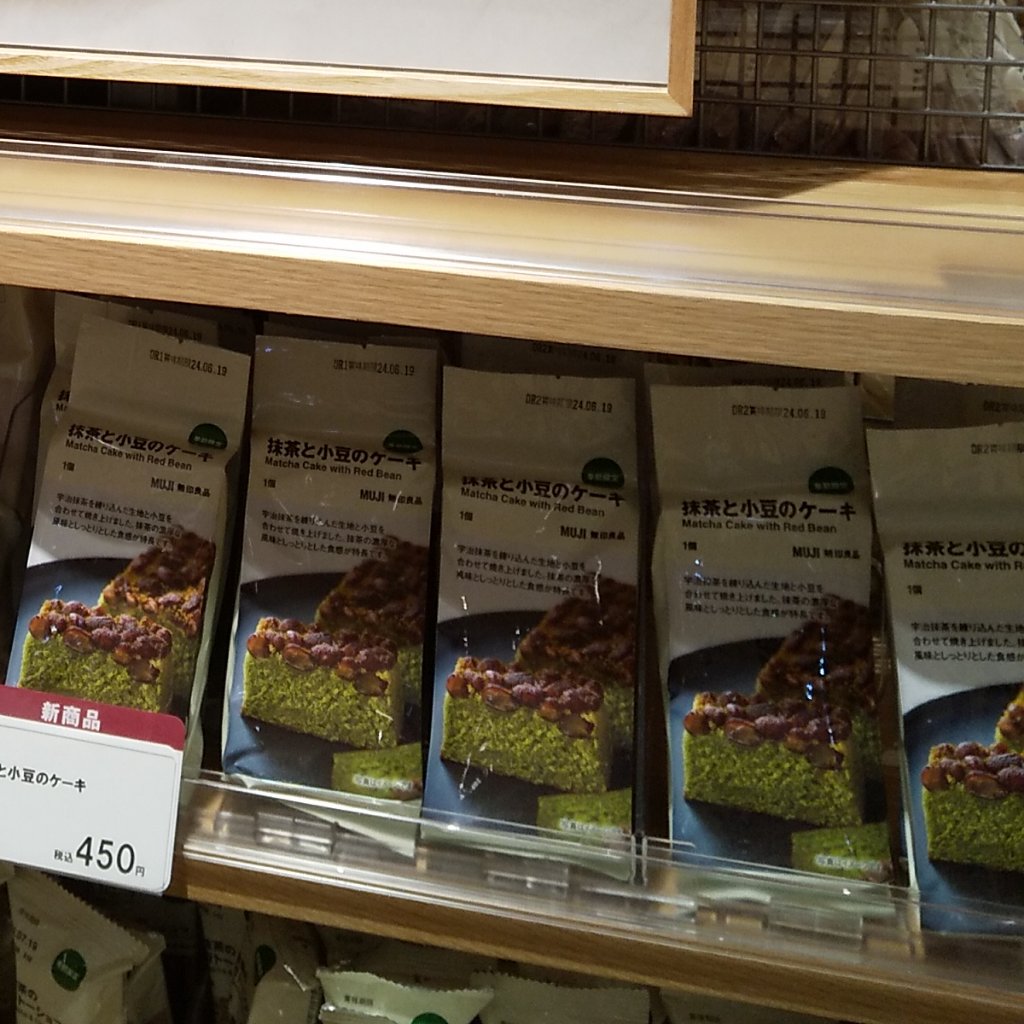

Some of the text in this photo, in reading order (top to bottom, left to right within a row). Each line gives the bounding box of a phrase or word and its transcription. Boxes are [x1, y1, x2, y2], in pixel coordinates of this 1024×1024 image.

[67, 423, 215, 463] 抹茶と小豆のケーキ
[65, 440, 193, 471] Matcha Cake with Red Bean
[267, 437, 422, 471] 抹茶と小豆のケーキ
[265, 456, 402, 481] Matcha Cake with Red Bean
[150, 477, 211, 497] MUJI 無印良品
[360, 489, 423, 506] MUJI 無印良品
[461, 475, 626, 507] 抹茶と小豆のケーキ
[461, 487, 605, 517] Matcha Cake with Red Bean
[681, 499, 857, 521] 抹茶と小豆のケーキ
[560, 525, 586, 539] MUJI
[682, 519, 838, 534] Matcha Cake with Red Bean
[682, 541, 697, 551] 1個
[792, 546, 821, 558] MUJI
[903, 558, 948, 570] Matcha
[951, 559, 982, 571] Cake
[984, 560, 1012, 571] with
[906, 584, 922, 596] 1個
[40, 701, 102, 732] 新商品
